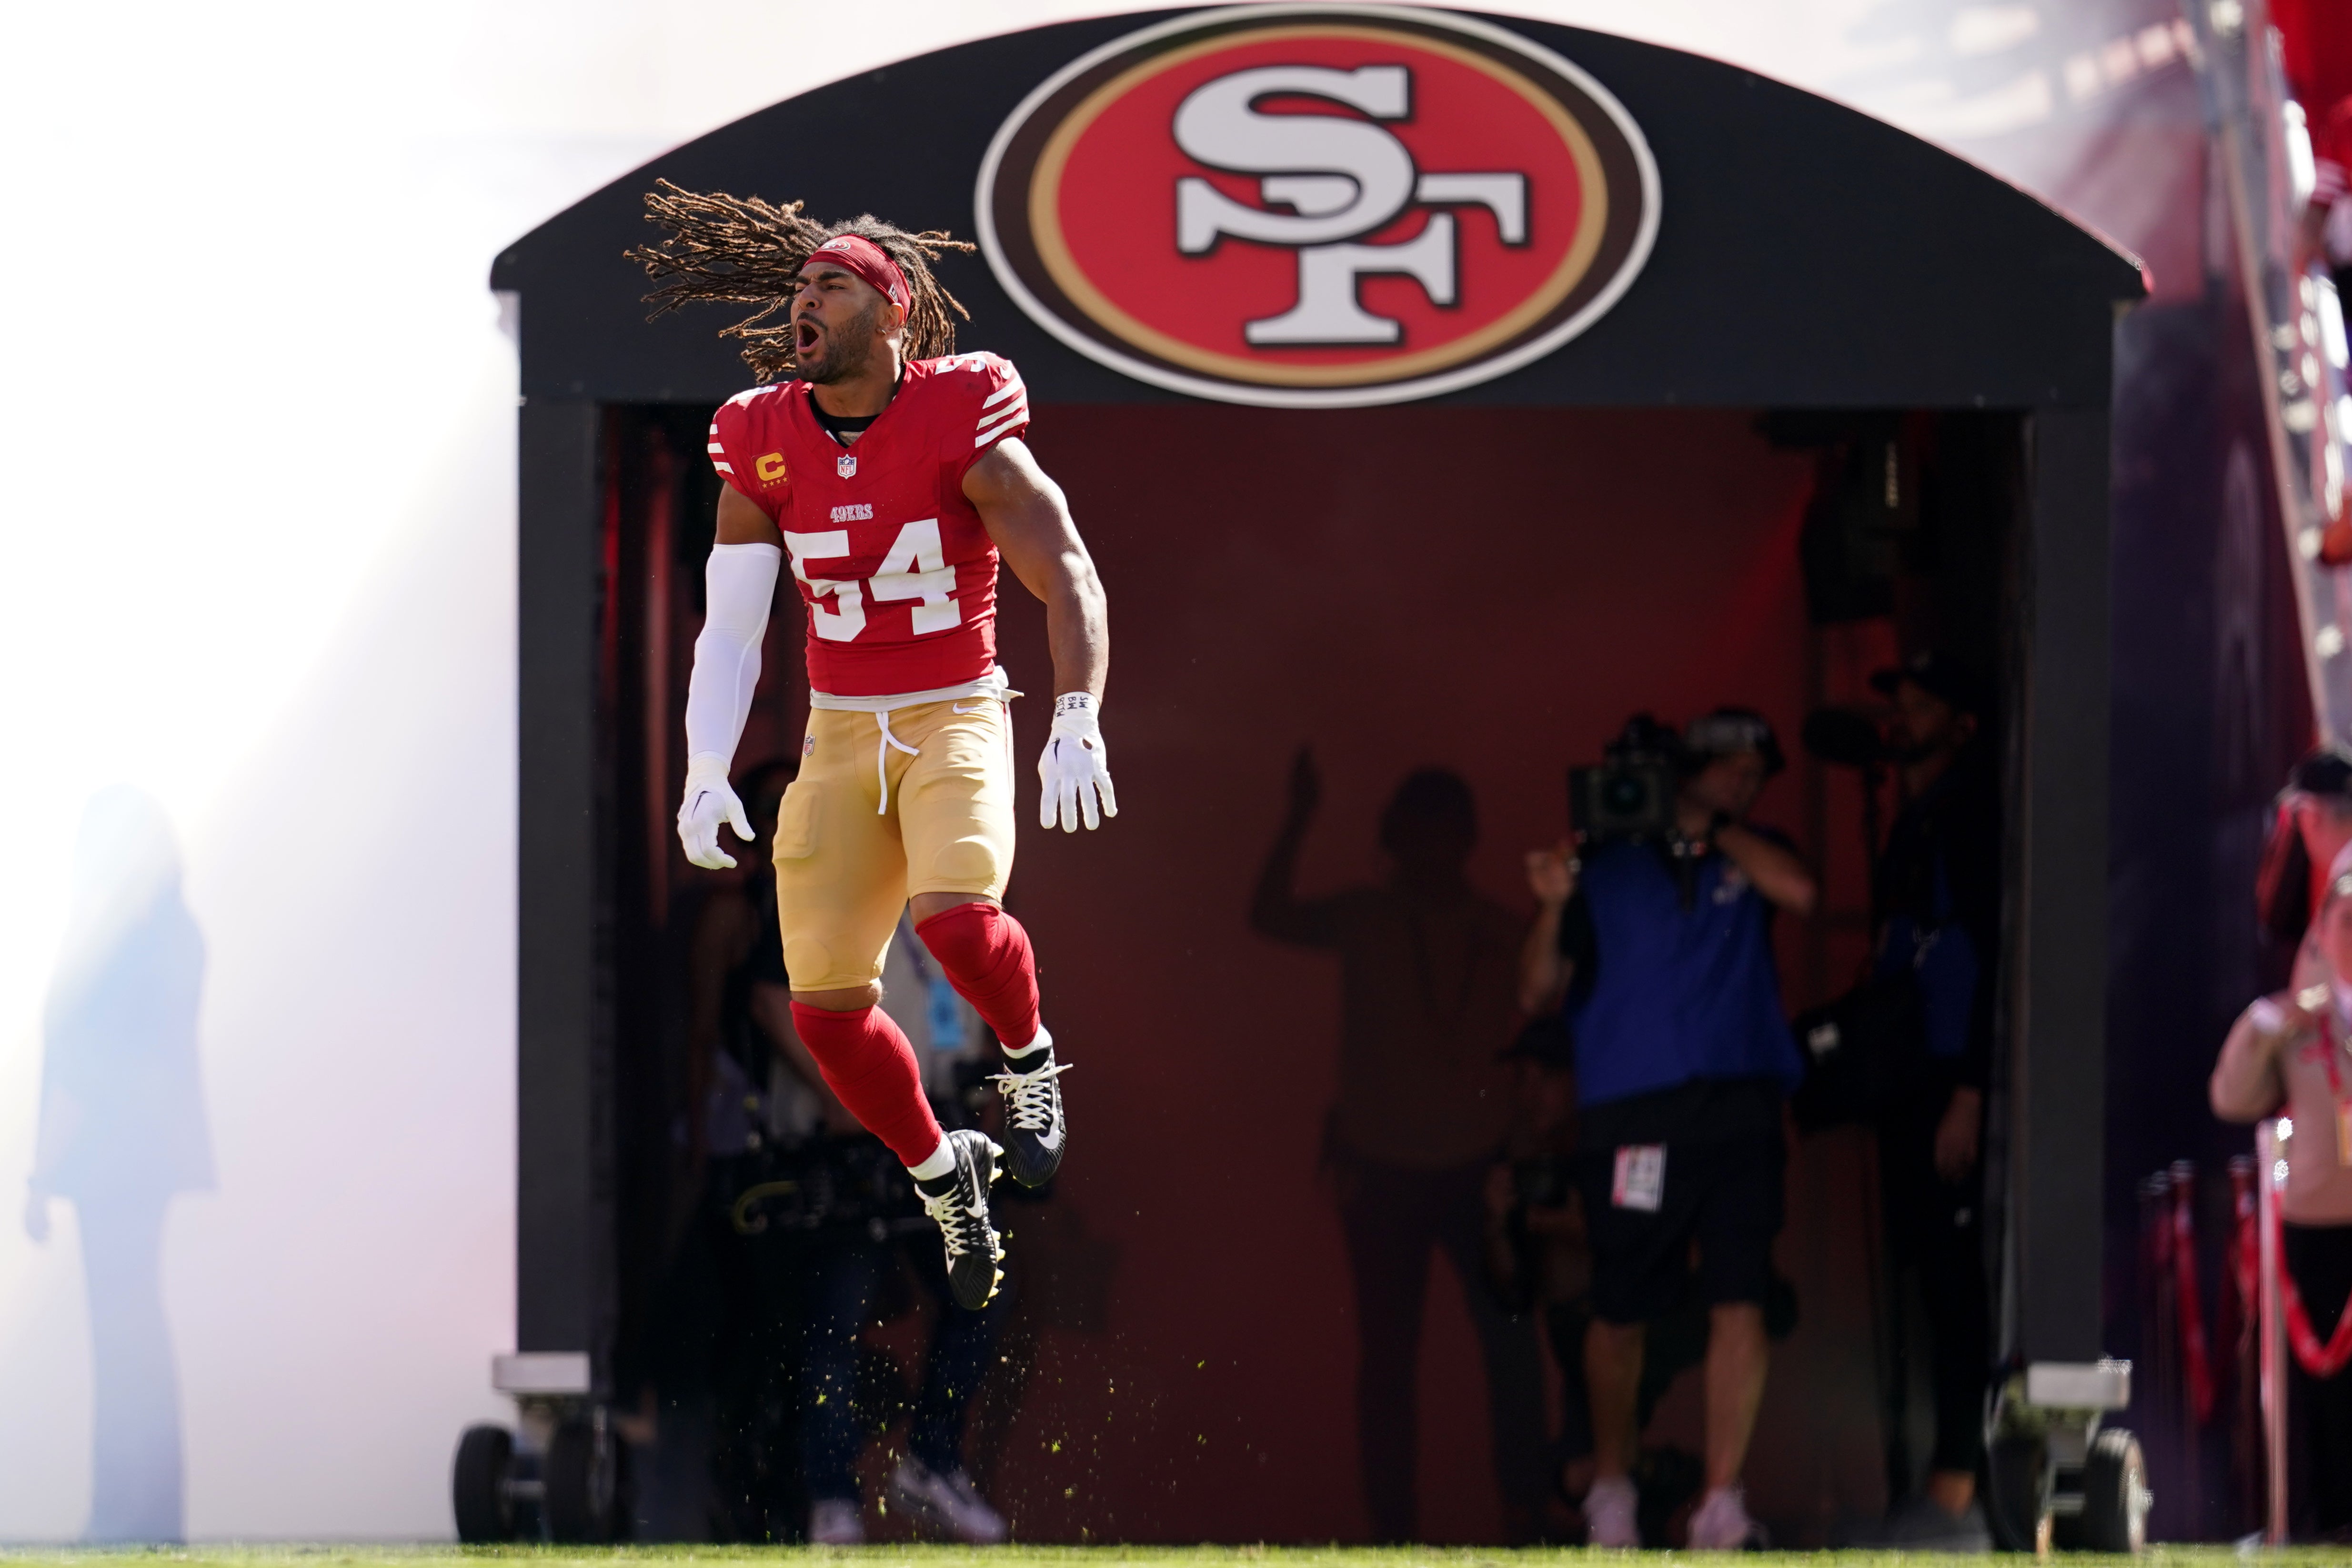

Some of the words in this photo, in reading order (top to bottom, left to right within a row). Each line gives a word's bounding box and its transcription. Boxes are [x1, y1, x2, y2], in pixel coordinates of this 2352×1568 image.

[1172, 64, 1526, 345] SF
[755, 452, 785, 481] C
[841, 465, 853, 474] NFL
[830, 504, 873, 523] 49ERS
[784, 518, 961, 642] 54
[1067, 696, 1077, 709] BW
[1079, 696, 1088, 708] SW
